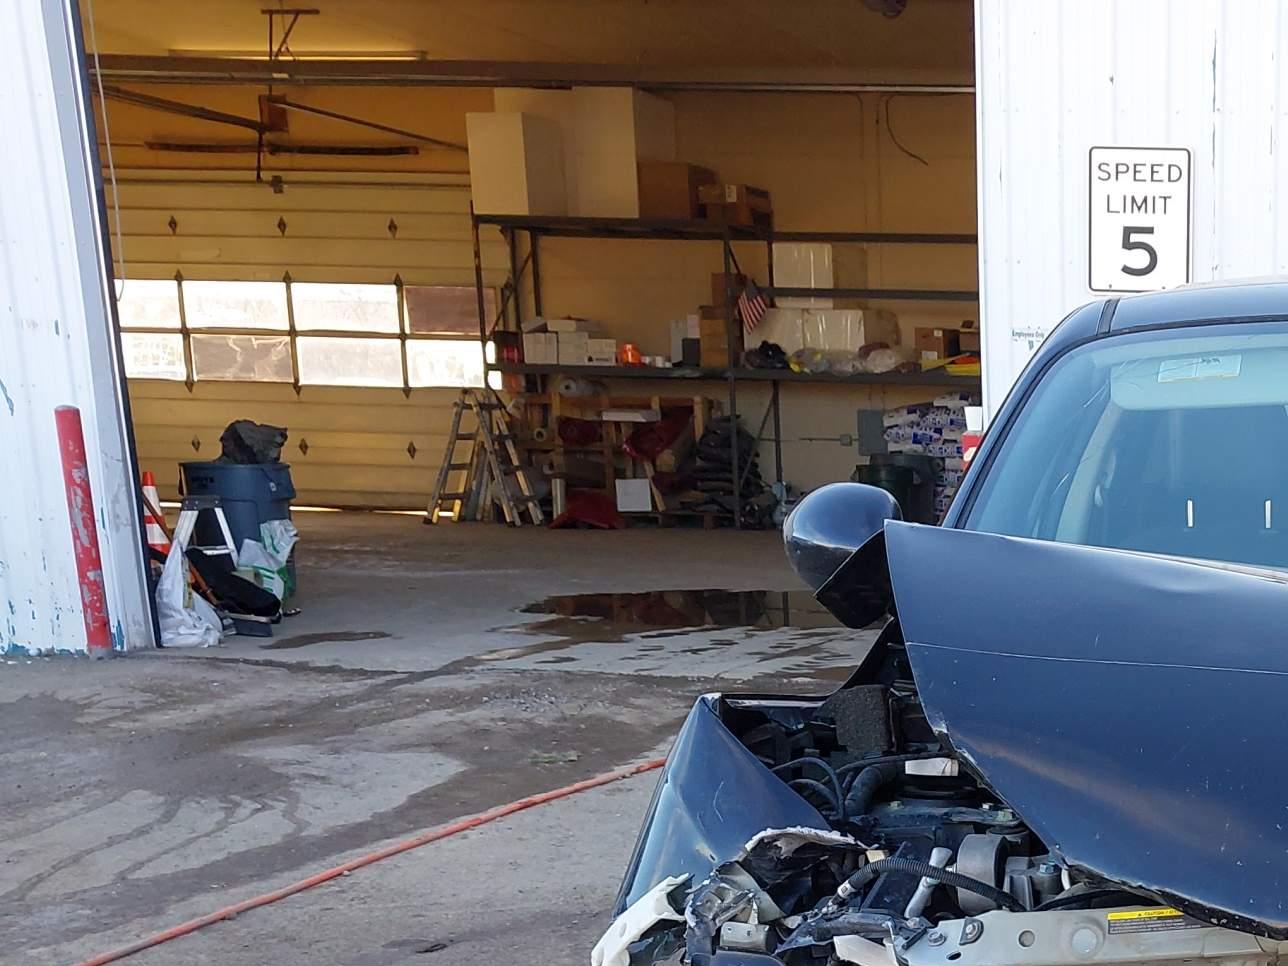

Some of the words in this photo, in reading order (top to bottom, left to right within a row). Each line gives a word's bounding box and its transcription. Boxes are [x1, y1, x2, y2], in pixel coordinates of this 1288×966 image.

[1097, 162, 1183, 183] SPEED
[1106, 194, 1172, 215] LIMIT
[1120, 225, 1158, 277] 5
